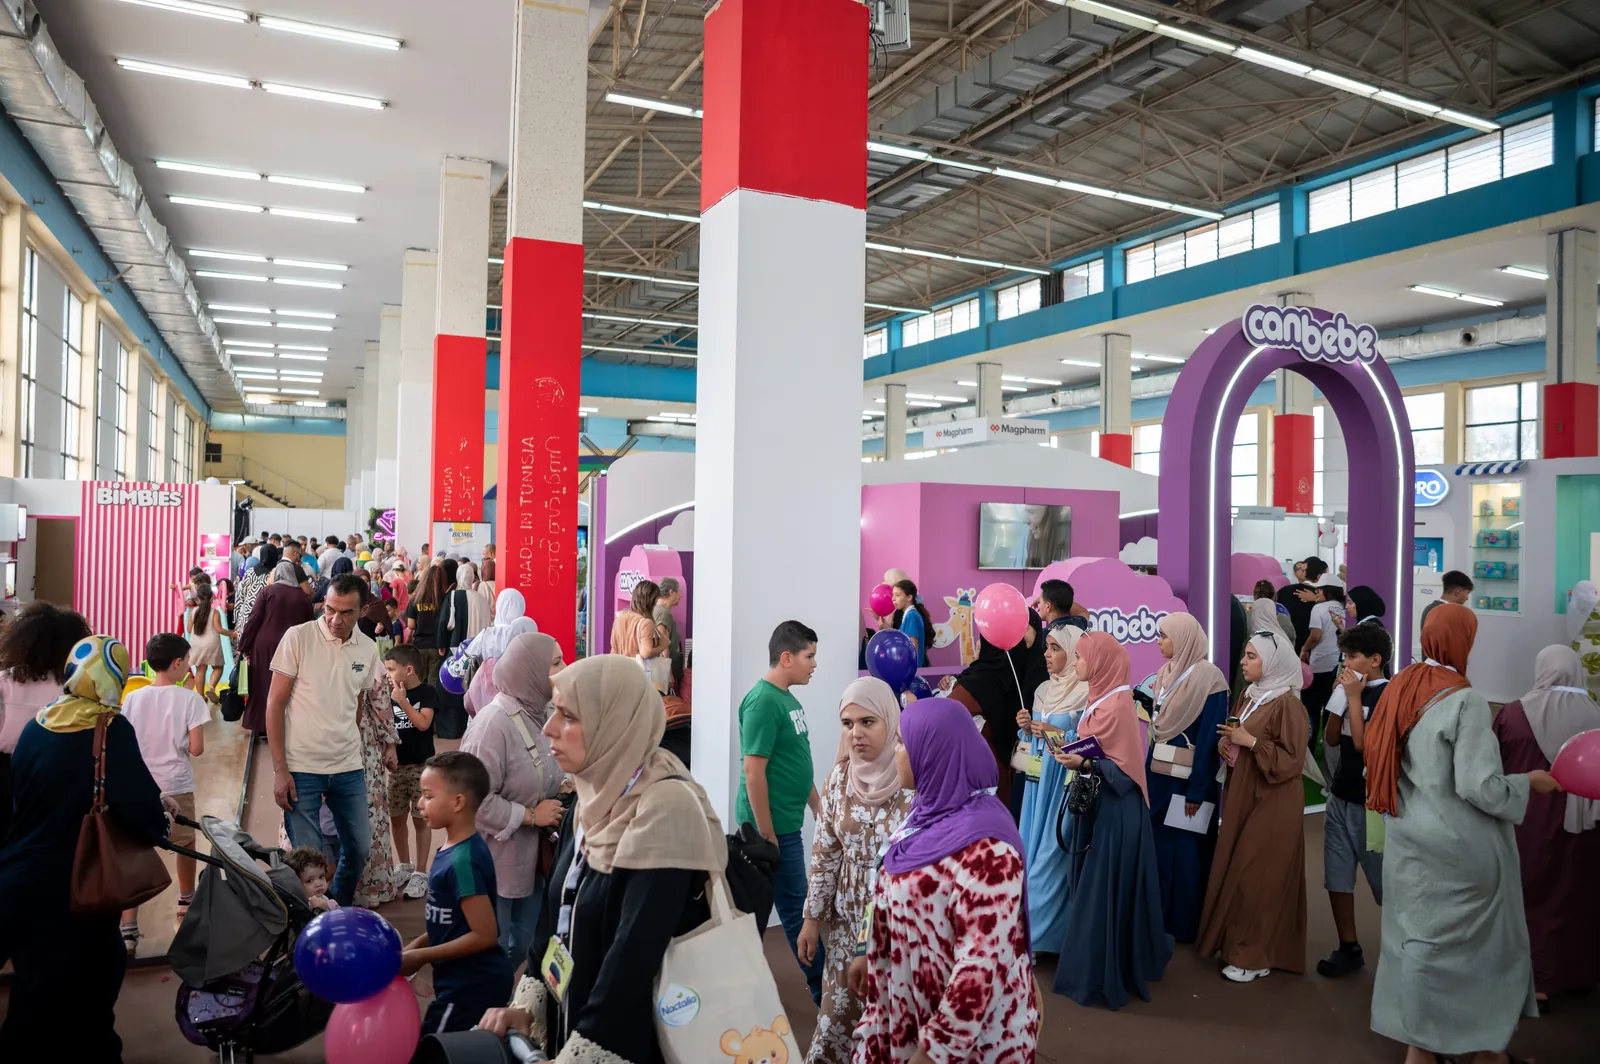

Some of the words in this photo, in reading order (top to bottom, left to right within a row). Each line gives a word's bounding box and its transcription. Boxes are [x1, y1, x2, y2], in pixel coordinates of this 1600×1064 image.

[1246, 308, 1376, 360] canbebe
[942, 427, 974, 439] Magpharm
[1001, 424, 1046, 436] Magpharm
[519, 436, 535, 506] TUNISIA
[519, 511, 533, 530] IN
[519, 535, 534, 587] MADE
[1088, 610, 1163, 641] anbeb
[425, 903, 453, 925] STE
[661, 995, 697, 1016] Nactalia
